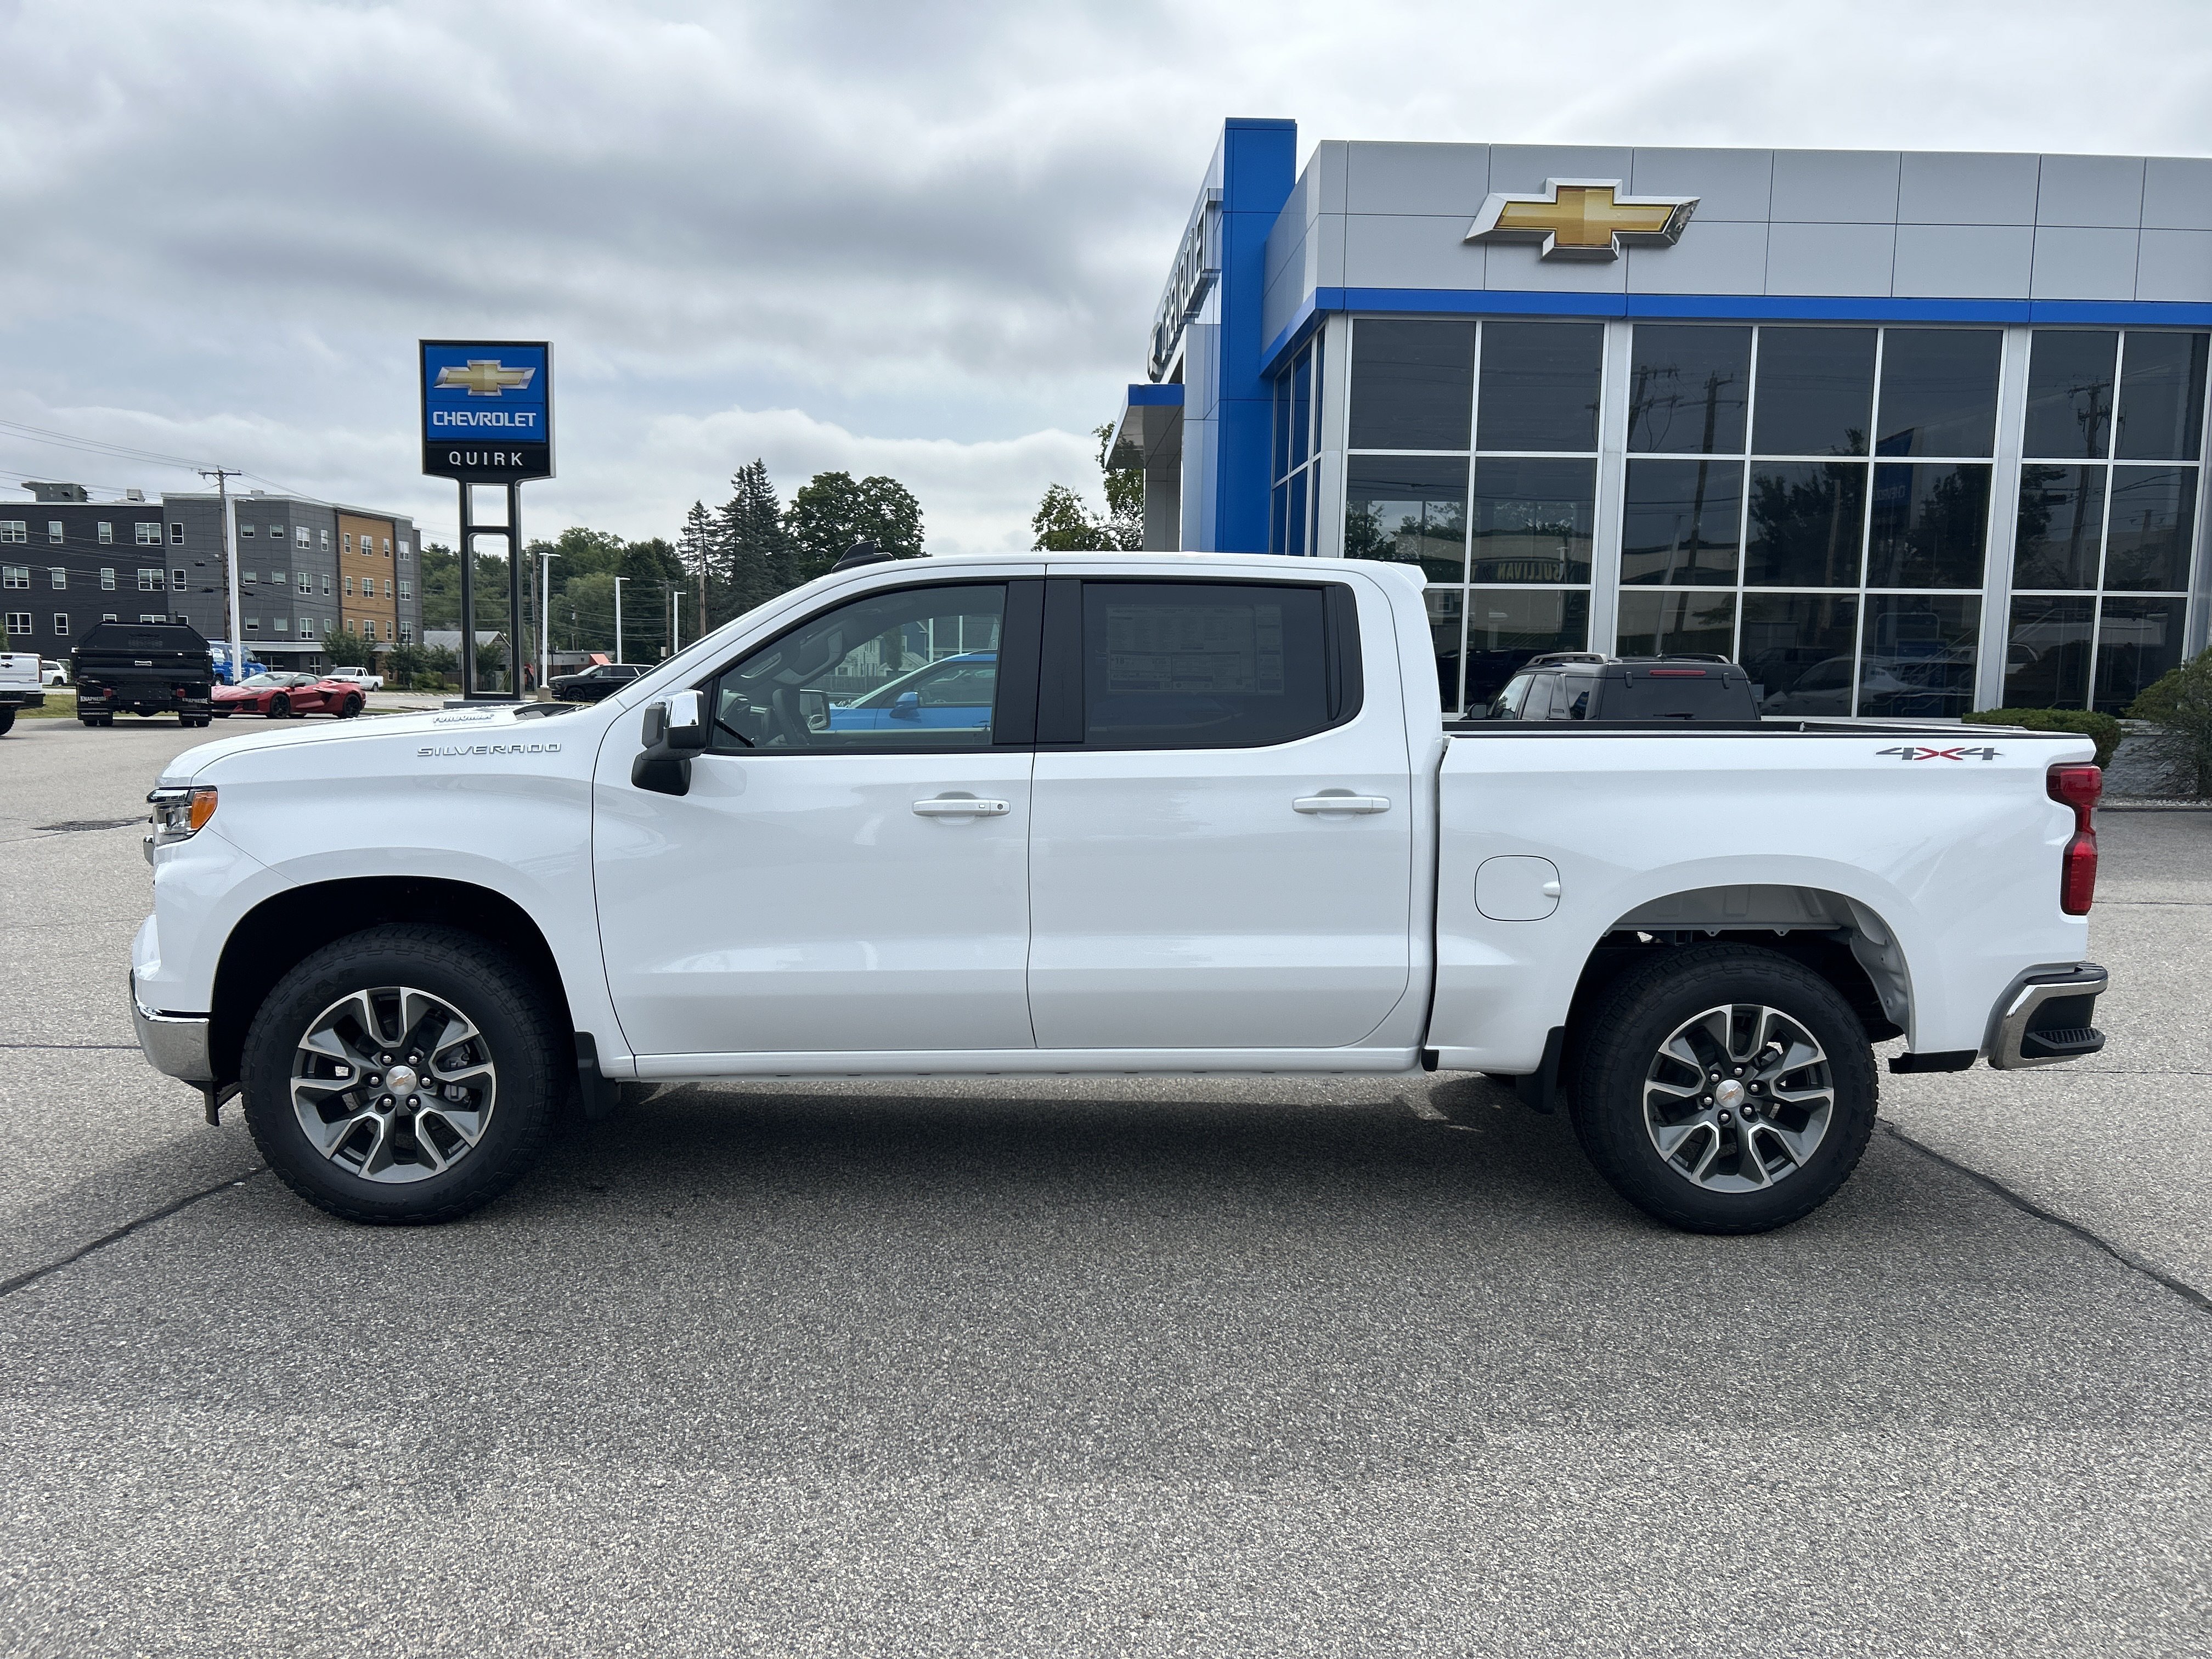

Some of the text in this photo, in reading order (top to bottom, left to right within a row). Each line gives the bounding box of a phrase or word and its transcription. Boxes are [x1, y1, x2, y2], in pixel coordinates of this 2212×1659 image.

[1161, 188, 1209, 363] CHEVROLET
[433, 411, 536, 427] CHEVROLET
[449, 451, 523, 466] QUIRK
[417, 743, 561, 757] SILVERADO
